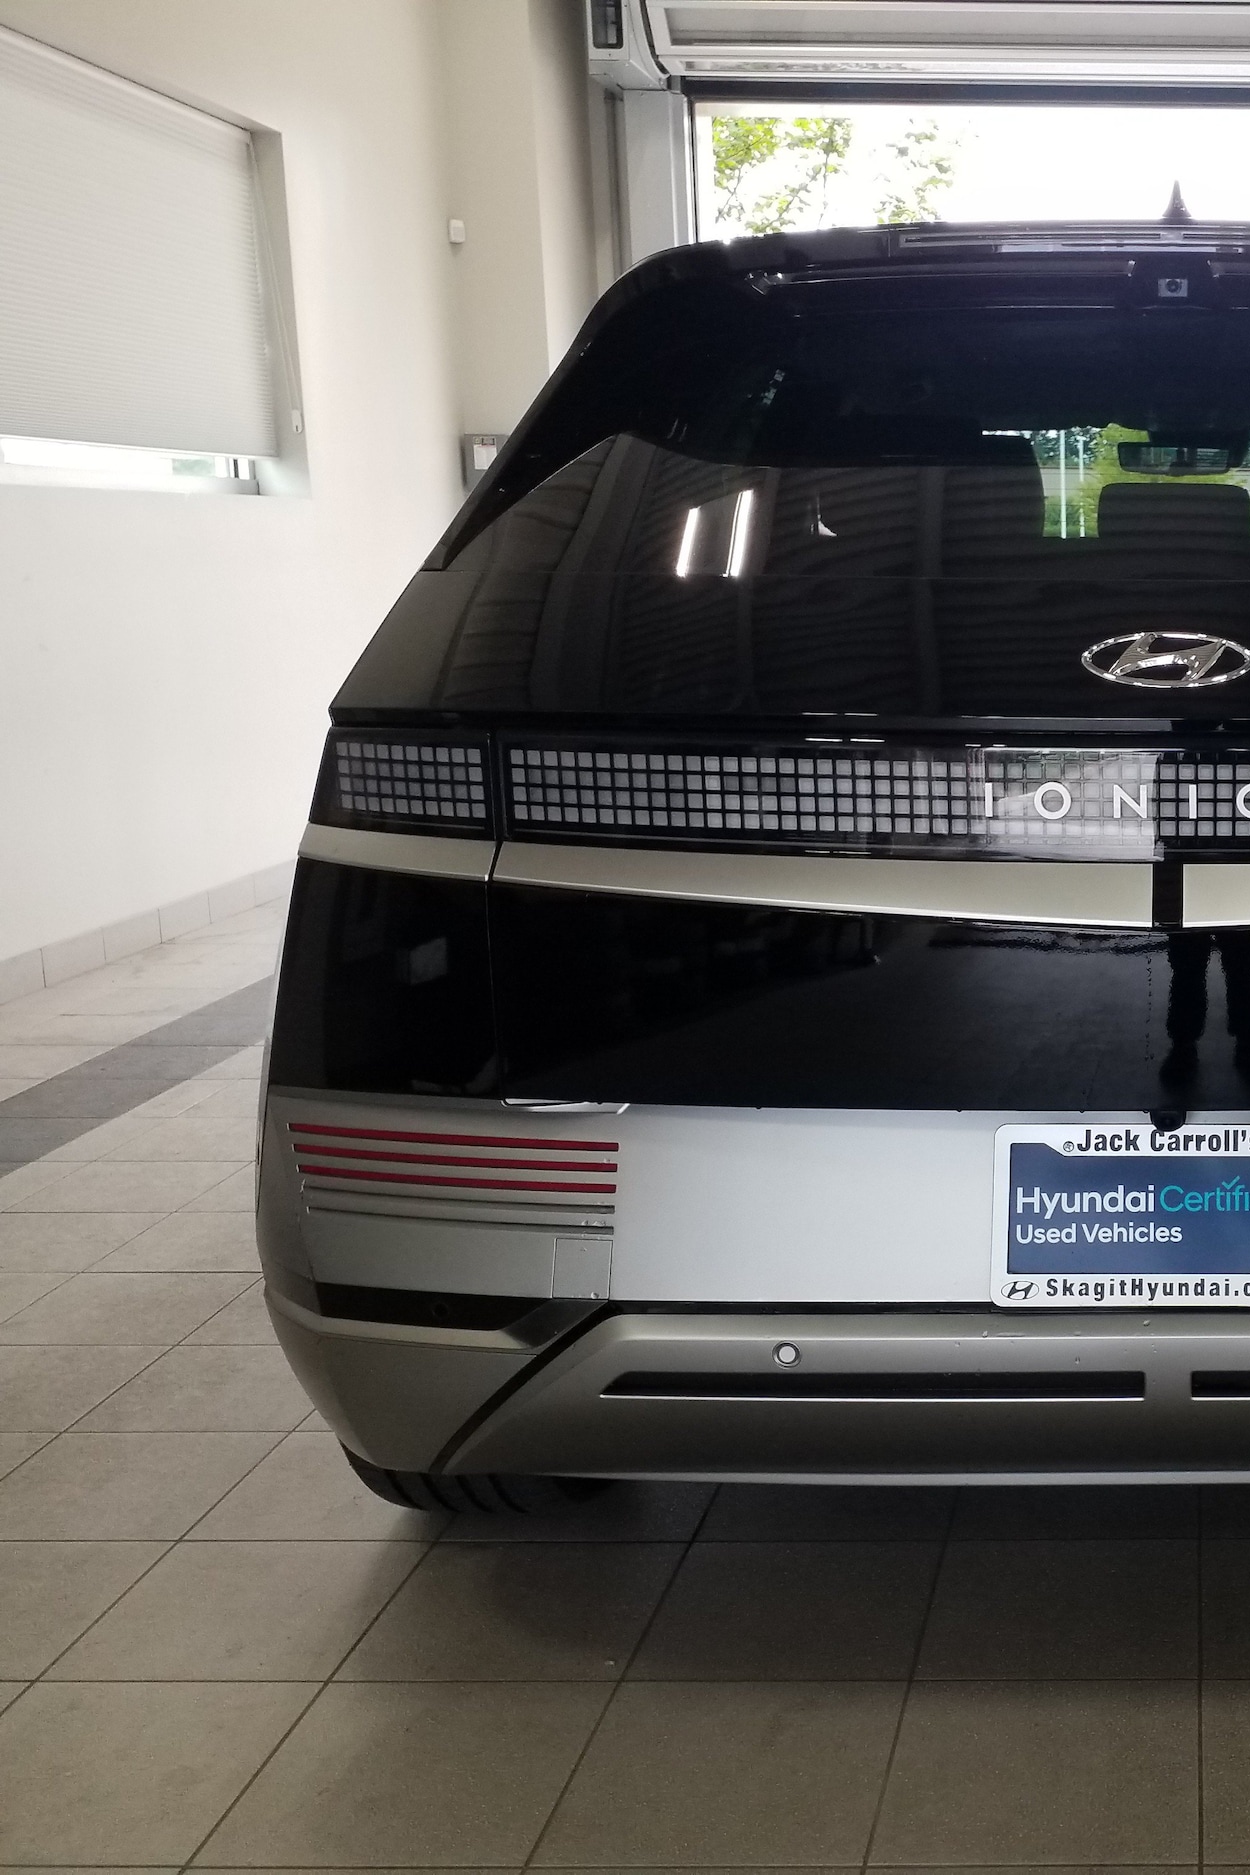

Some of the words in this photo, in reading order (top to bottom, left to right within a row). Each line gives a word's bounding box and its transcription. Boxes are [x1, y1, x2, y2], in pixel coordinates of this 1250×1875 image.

[1077, 1129, 1140, 1152] Jack
[1015, 1184, 1155, 1220] Hyundai
[1016, 1223, 1077, 1244] Used
[1082, 1223, 1183, 1244] Vehicles
